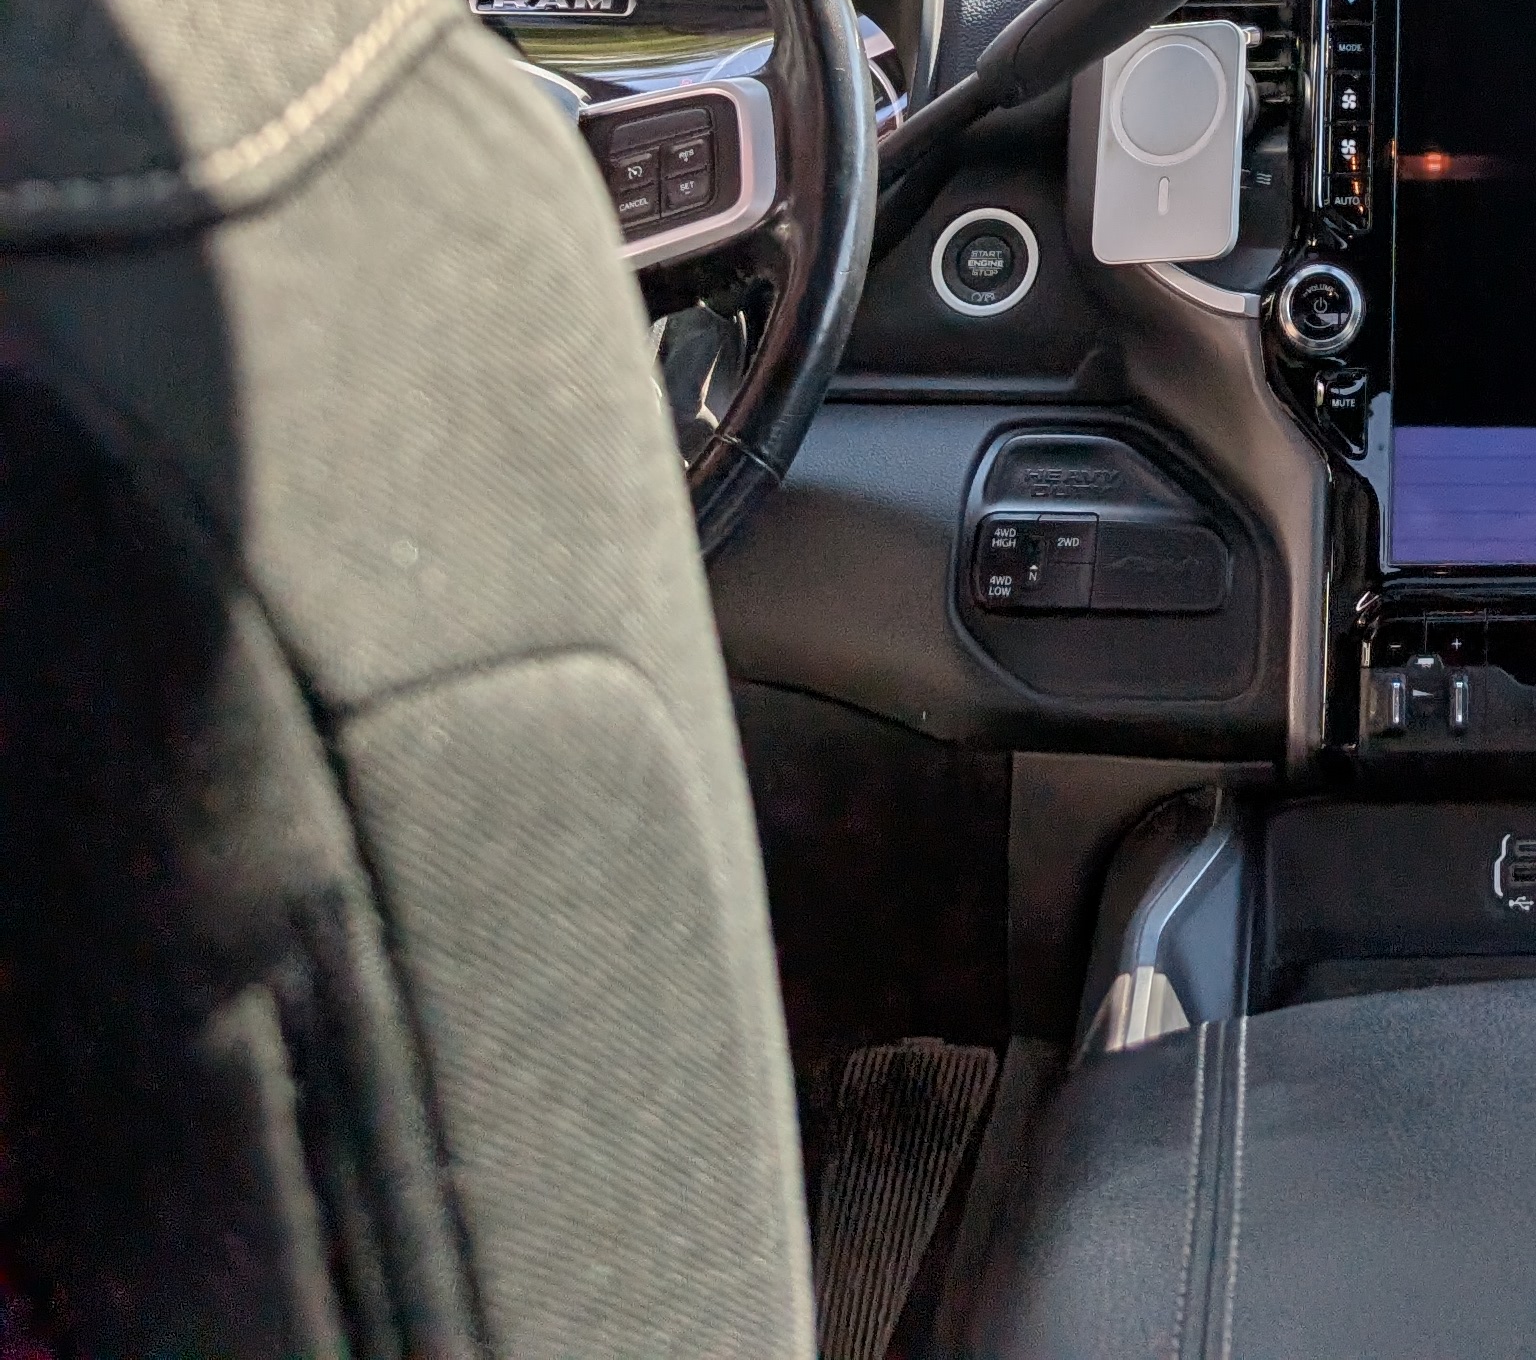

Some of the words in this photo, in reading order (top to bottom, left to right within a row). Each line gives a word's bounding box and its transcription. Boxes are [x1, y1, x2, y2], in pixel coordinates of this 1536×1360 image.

[1338, 43, 1363, 52] MODE
[680, 180, 695, 191] SET
[619, 197, 649, 212] CANCEL
[1334, 196, 1361, 207] AUTO
[971, 250, 1003, 259] START
[967, 259, 1004, 268] ENGINE
[971, 269, 999, 277] STOP
[1331, 398, 1356, 408] MUTE
[1024, 467, 1120, 483] HEAVY
[994, 528, 1017, 538] 4WD
[991, 538, 1017, 548] HIGH
[1057, 537, 1080, 548] 2WD
[989, 575, 1012, 586] 4WD
[1028, 571, 1038, 582] N
[988, 586, 1012, 597] LOW
